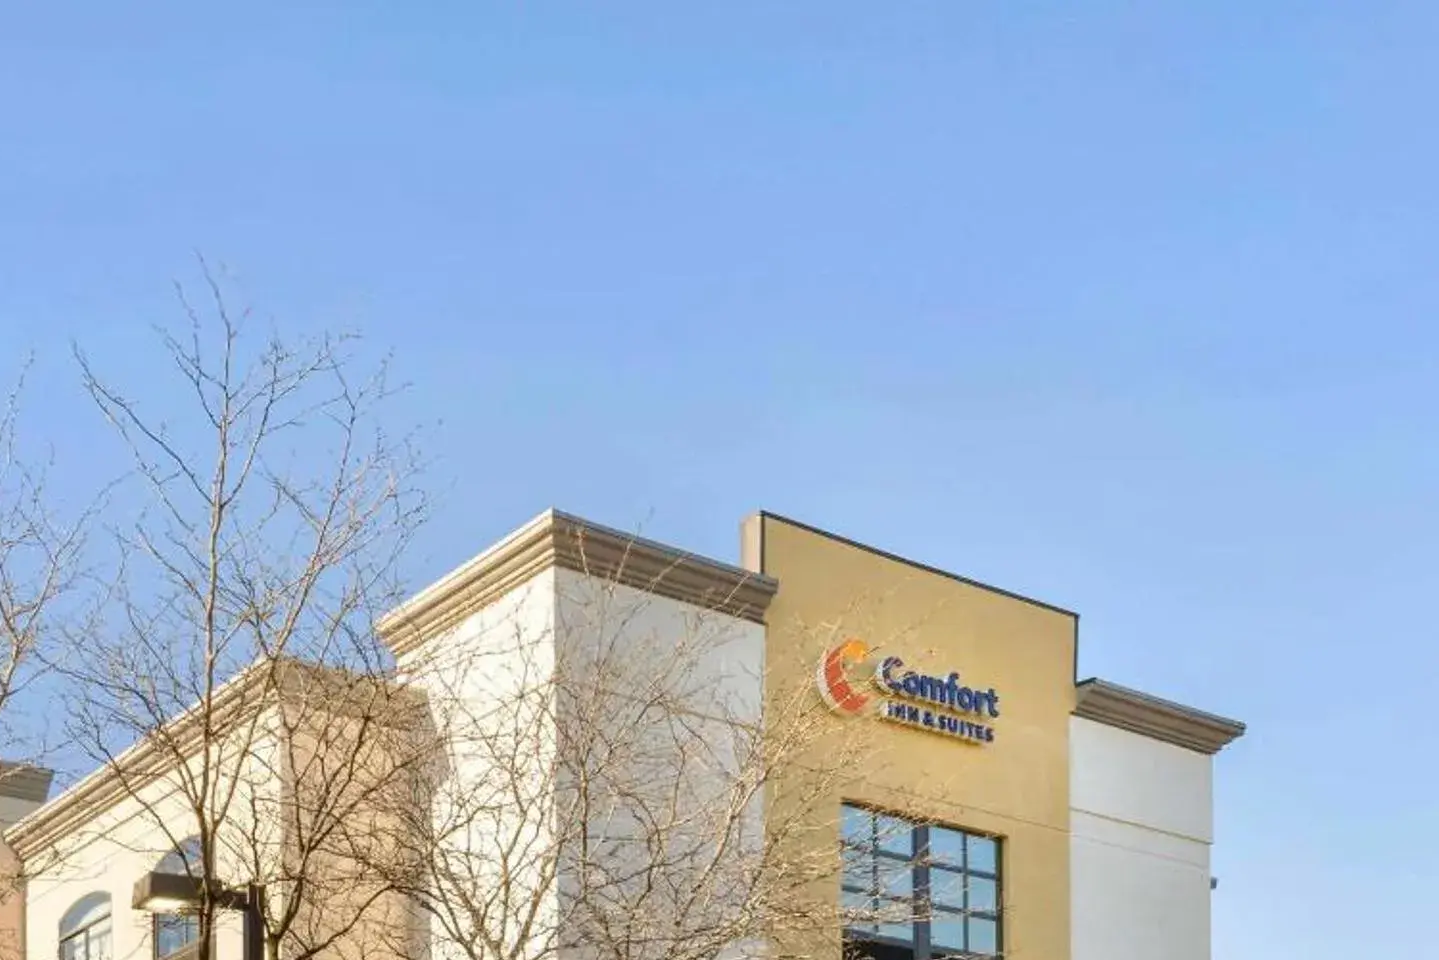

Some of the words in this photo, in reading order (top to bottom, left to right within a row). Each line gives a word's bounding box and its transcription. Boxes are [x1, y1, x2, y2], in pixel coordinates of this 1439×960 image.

[878, 656, 999, 718] Comfort
[887, 700, 919, 722] INN
[922, 710, 934, 726] &
[938, 713, 994, 743] SUITES
